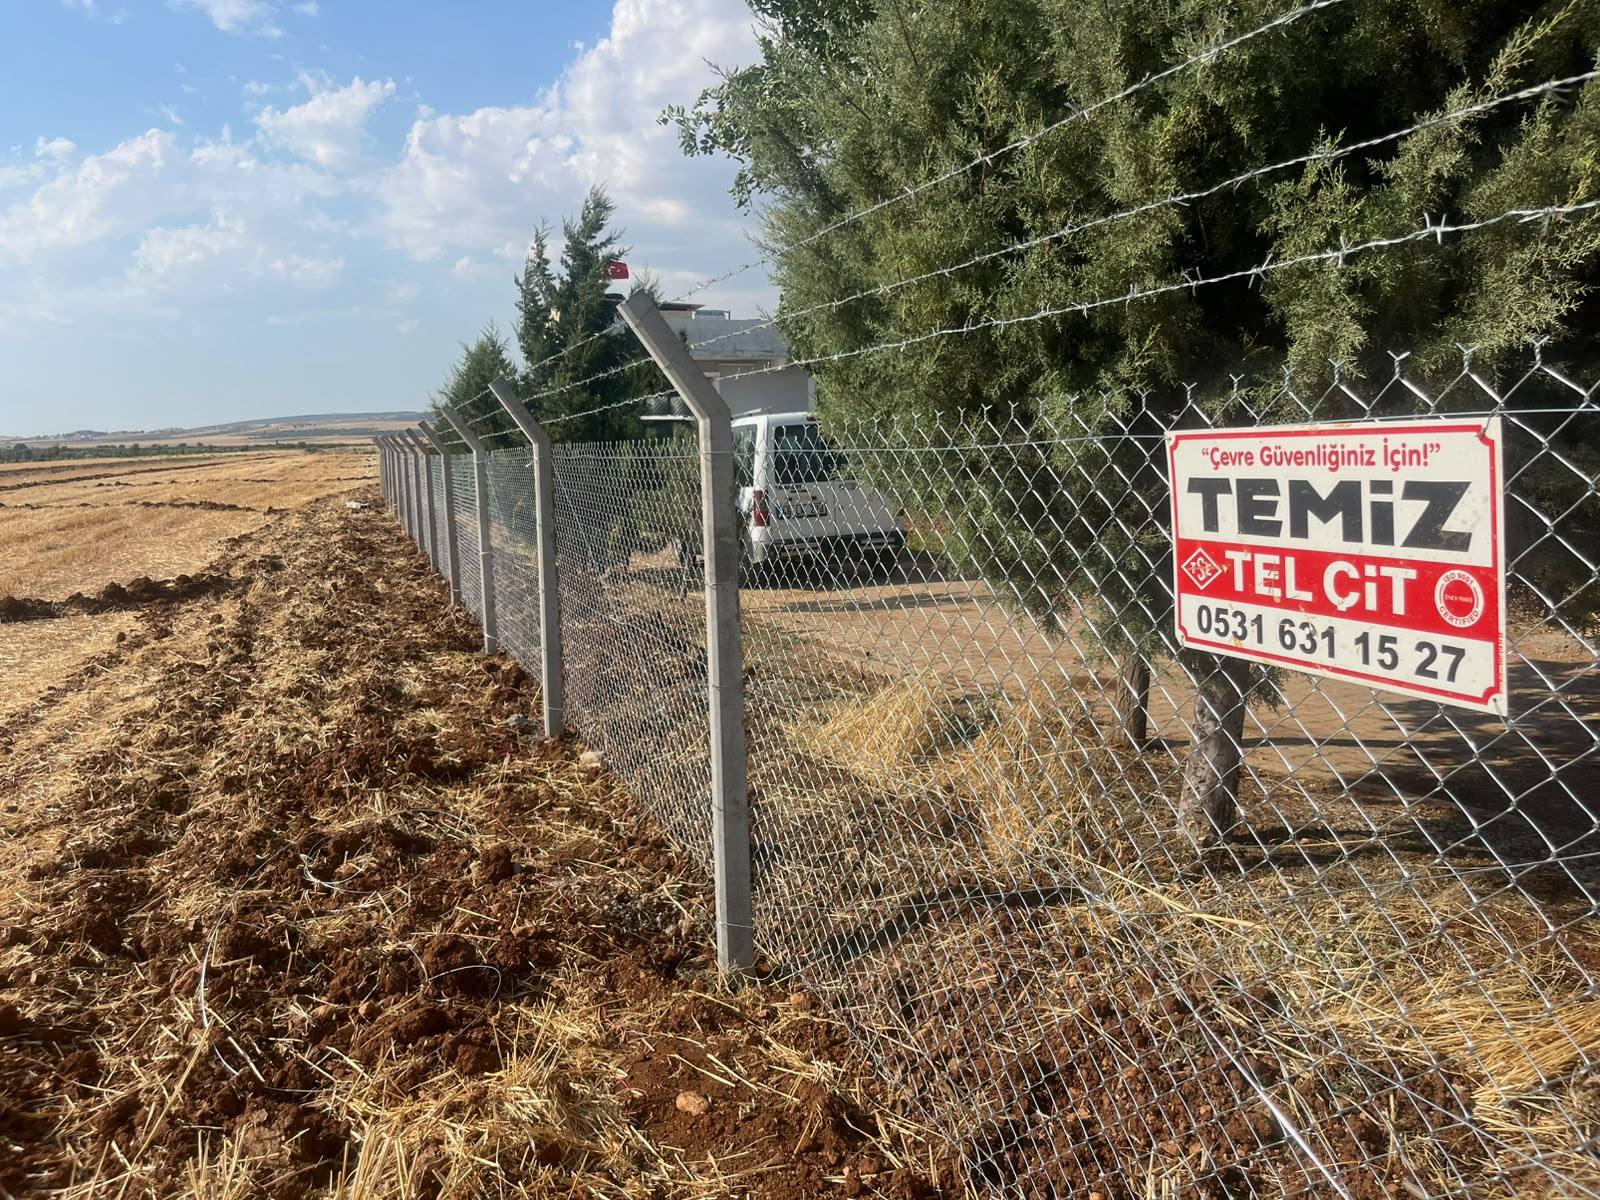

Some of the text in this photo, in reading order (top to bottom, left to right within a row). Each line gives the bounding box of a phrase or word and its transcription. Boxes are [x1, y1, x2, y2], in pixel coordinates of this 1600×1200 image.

[1260, 444, 1376, 473] Güvenliğiniz
[1225, 550, 1313, 602] TEL
[1439, 606, 1479, 625] CERTIFIED
[1197, 604, 1264, 645] 0531
[1278, 618, 1336, 659] 631
[1354, 631, 1399, 671] 15
[1415, 641, 1466, 683] 27
